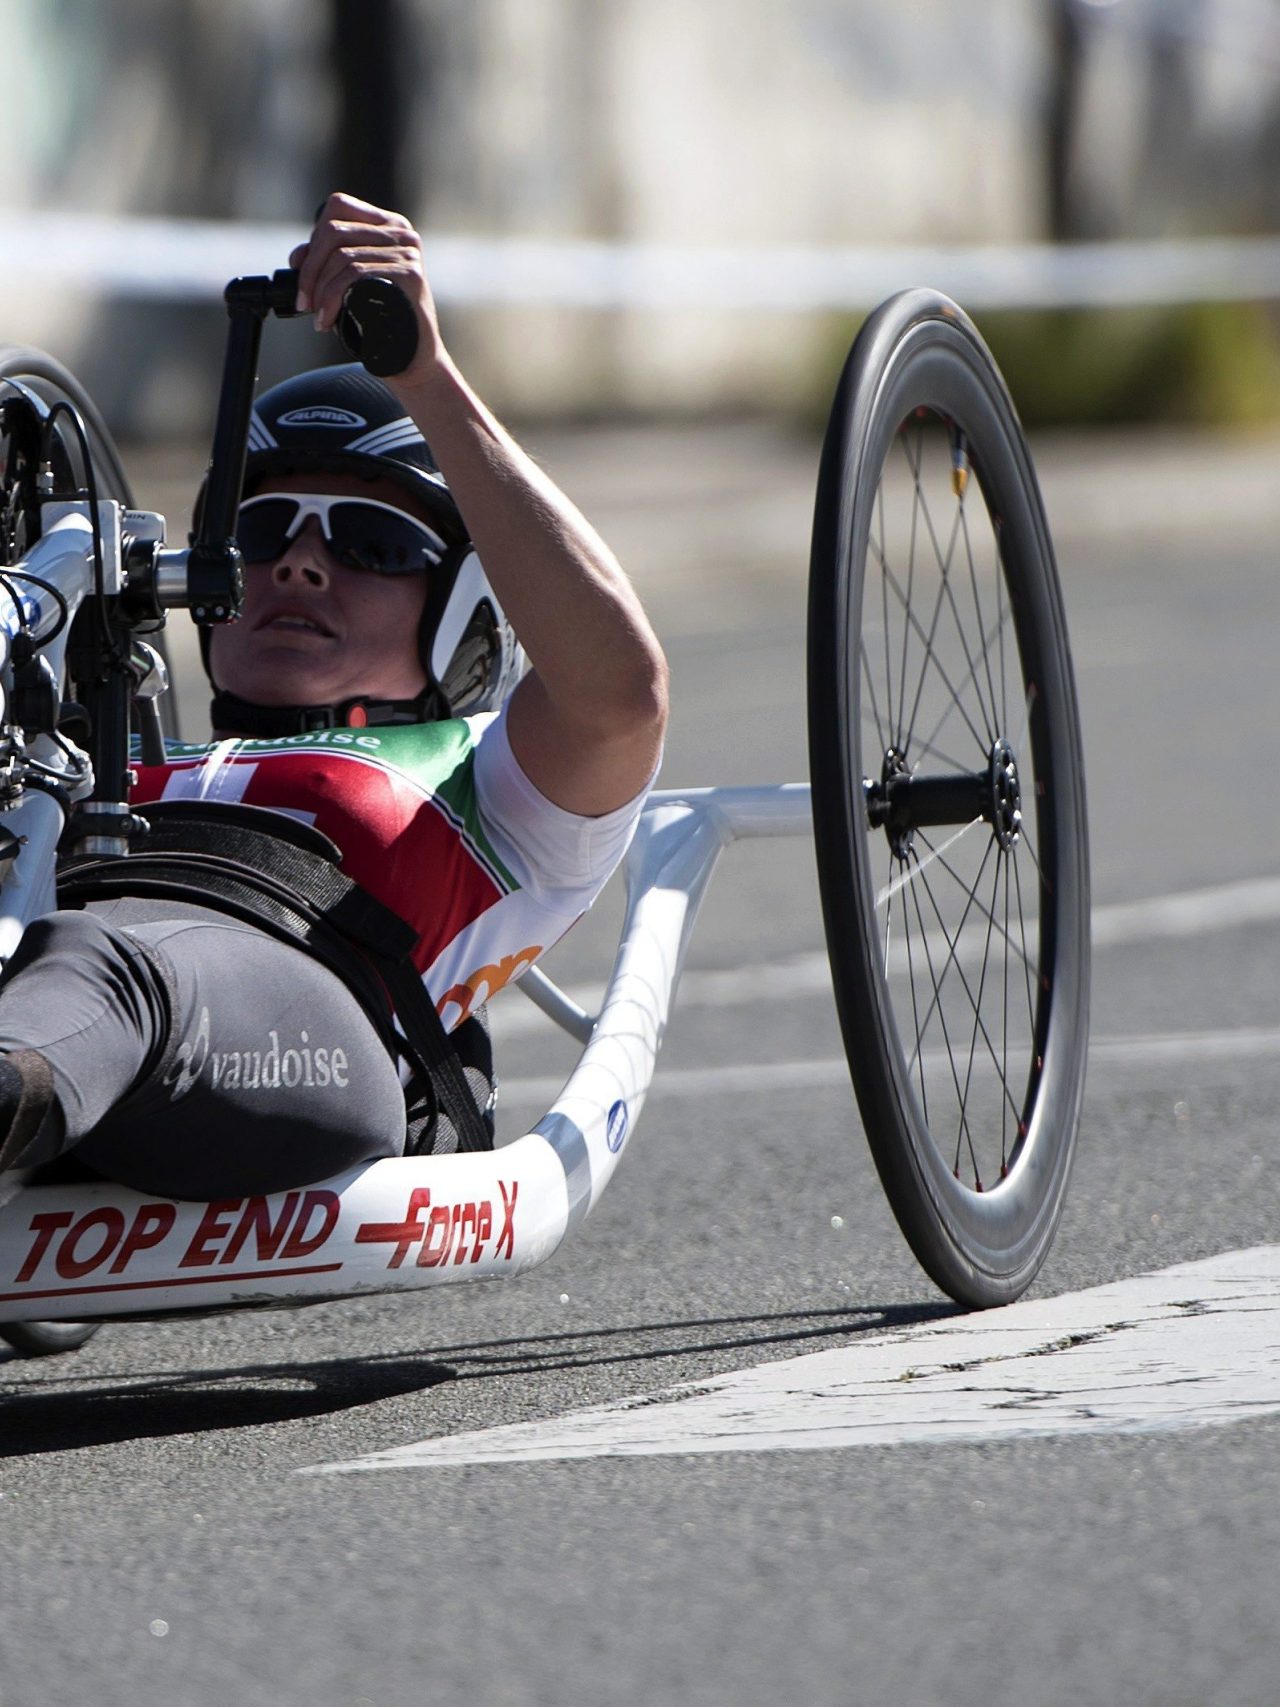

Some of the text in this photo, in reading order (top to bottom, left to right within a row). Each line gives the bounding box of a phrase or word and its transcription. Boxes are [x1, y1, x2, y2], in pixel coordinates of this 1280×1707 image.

[211, 1030, 349, 1090] vaudoise
[15, 1204, 178, 1283] TOP
[178, 1189, 341, 1268] END
